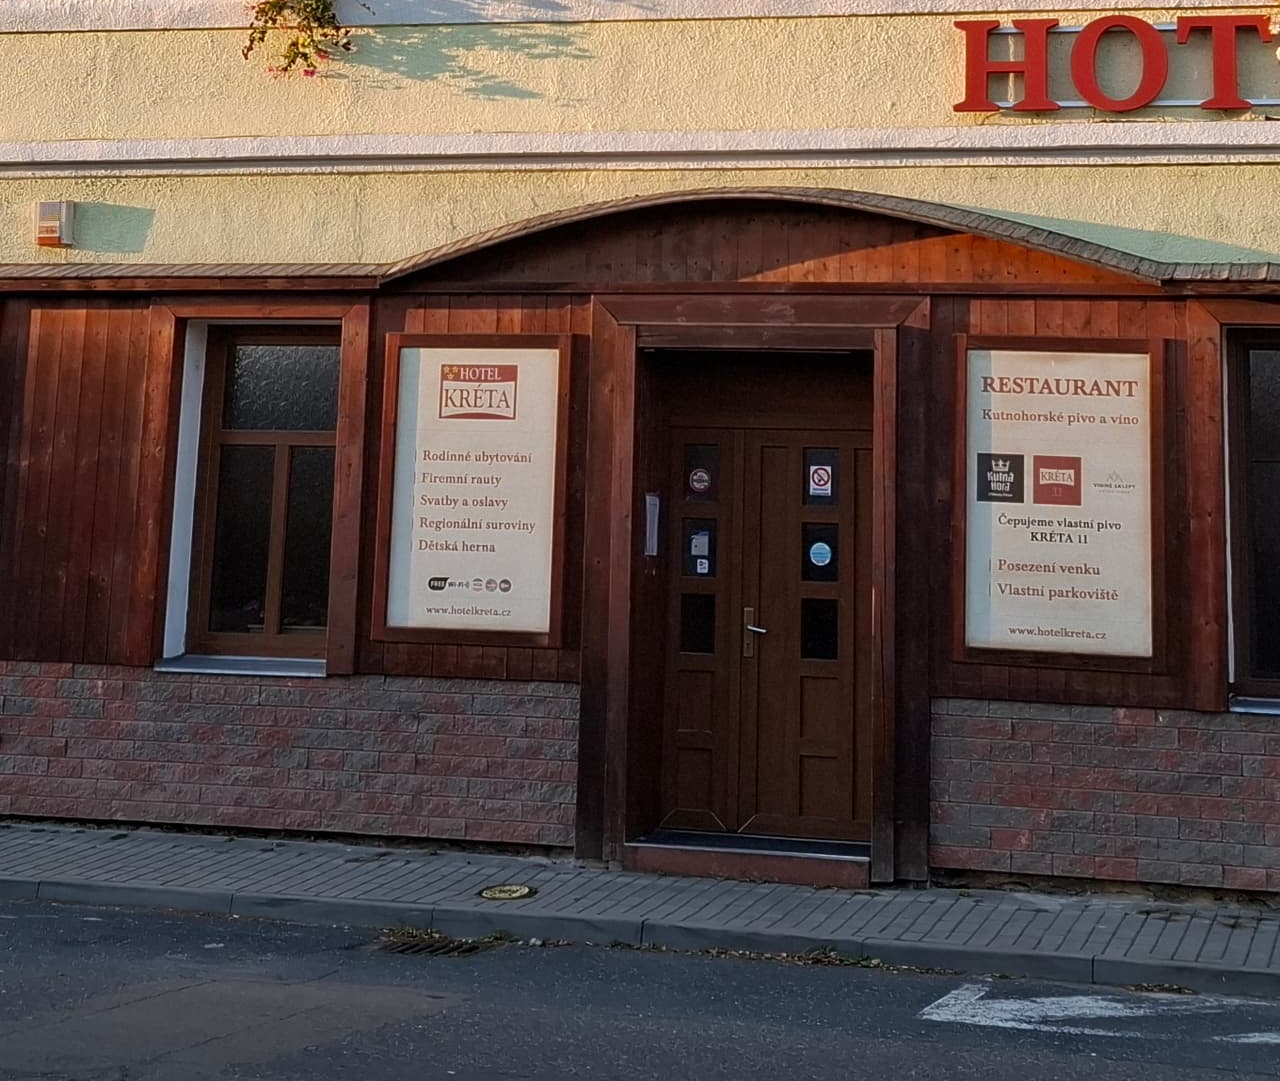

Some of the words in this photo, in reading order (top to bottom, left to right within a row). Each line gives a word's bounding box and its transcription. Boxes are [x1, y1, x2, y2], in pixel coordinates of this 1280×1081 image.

[460, 367, 501, 380] HOTEL
[981, 376, 1138, 397] RESTAURANT
[444, 384, 511, 408] KRÉTA
[983, 408, 1064, 422] Kutnohorské
[1068, 412, 1096, 426] pivo
[1099, 416, 1107, 424] a
[1109, 414, 1139, 425] víno
[475, 451, 532, 465] ubytování
[421, 472, 468, 484] Firemní
[471, 475, 501, 488] rauty
[1041, 471, 1073, 483] KRÉTA
[420, 495, 459, 509] Svatby
[462, 498, 468, 506] a
[472, 496, 508, 511] oslavy
[419, 517, 482, 532] Regionální
[485, 520, 536, 534] suroviny
[998, 512, 1054, 529] Čepujeme
[1057, 518, 1094, 529] vlastní
[1097, 520, 1121, 532] pivo
[1030, 530, 1074, 543] KRÉTA
[1078, 534, 1088, 544] 11
[418, 539, 458, 551] Dětská
[462, 541, 496, 552] herna
[998, 559, 1056, 573] Posezení
[1060, 563, 1100, 575] venku
[997, 583, 1045, 597] Vlastní
[1048, 586, 1119, 601] parkoviště
[426, 605, 512, 616] www.hotelkreta.cz
[1008, 626, 1107, 639] www.hotelkreta.cz
